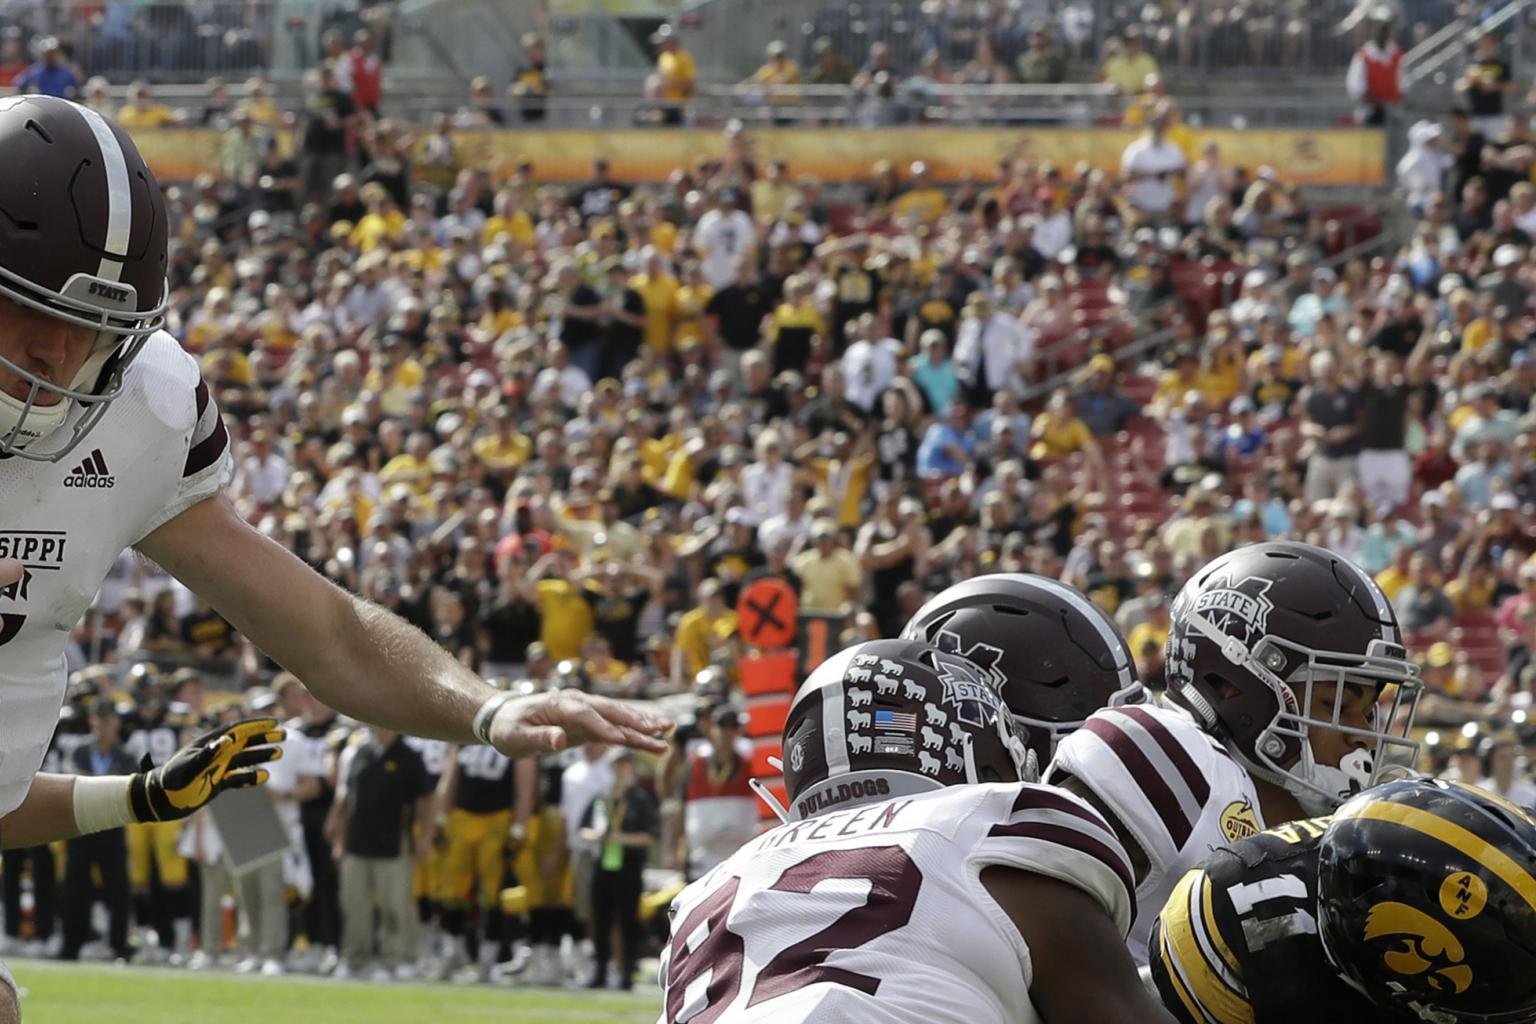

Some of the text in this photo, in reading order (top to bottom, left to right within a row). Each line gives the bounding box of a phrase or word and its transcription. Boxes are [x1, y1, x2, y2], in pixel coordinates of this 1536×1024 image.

[88, 282, 129, 302] STATE
[64, 474, 115, 488] adidas
[1198, 592, 1253, 617] STATE
[798, 777, 890, 820] BULLDOGS
[1227, 874, 1317, 952] 11
